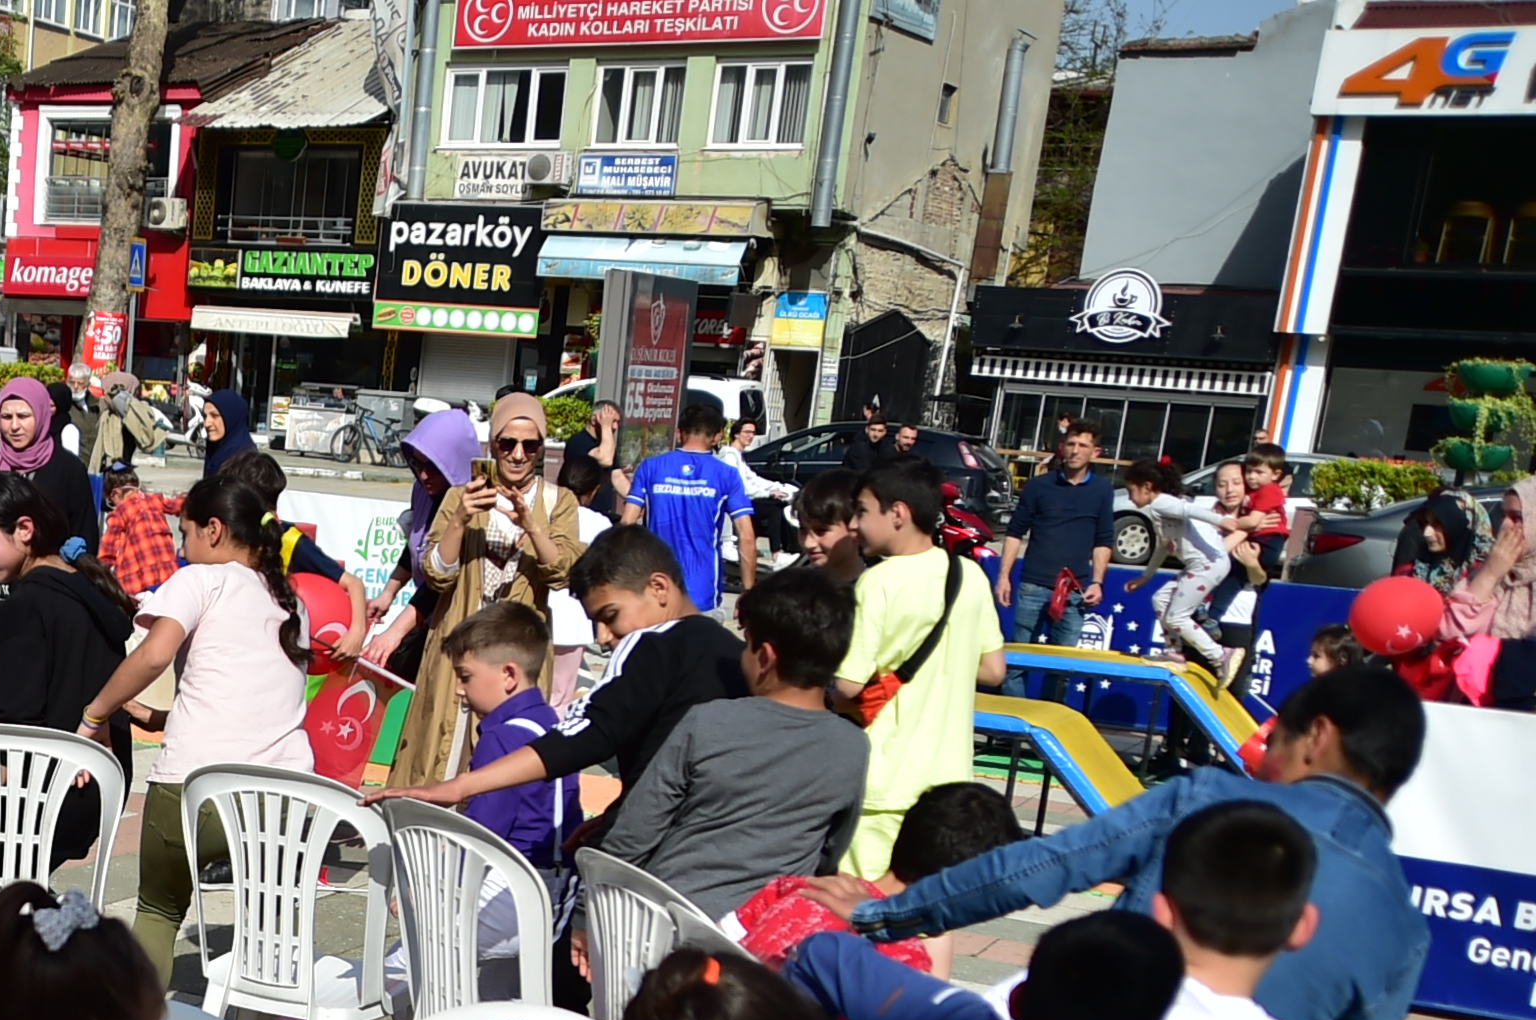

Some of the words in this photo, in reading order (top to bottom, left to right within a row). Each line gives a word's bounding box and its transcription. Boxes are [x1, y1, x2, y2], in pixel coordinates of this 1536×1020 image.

[517, 2, 603, 21] MİLLİYETÇİ
[607, 0, 682, 17] HAREKET
[527, 22, 576, 37] KADIN
[580, 19, 650, 36] KOLLARI
[654, 14, 739, 36] TEŞKİLATI
[614, 157, 661, 165] SERBEST
[460, 160, 527, 180] AVUKAT
[458, 182, 493, 195] OSMAN
[601, 174, 625, 187] MALİ
[627, 174, 672, 189] MÜŞAVİR
[389, 214, 533, 257] pazarköy
[401, 252, 512, 292] DÖNER
[241, 277, 302, 292] BAKLAVA
[302, 282, 312, 291] &
[375, 516, 400, 527] BUR
